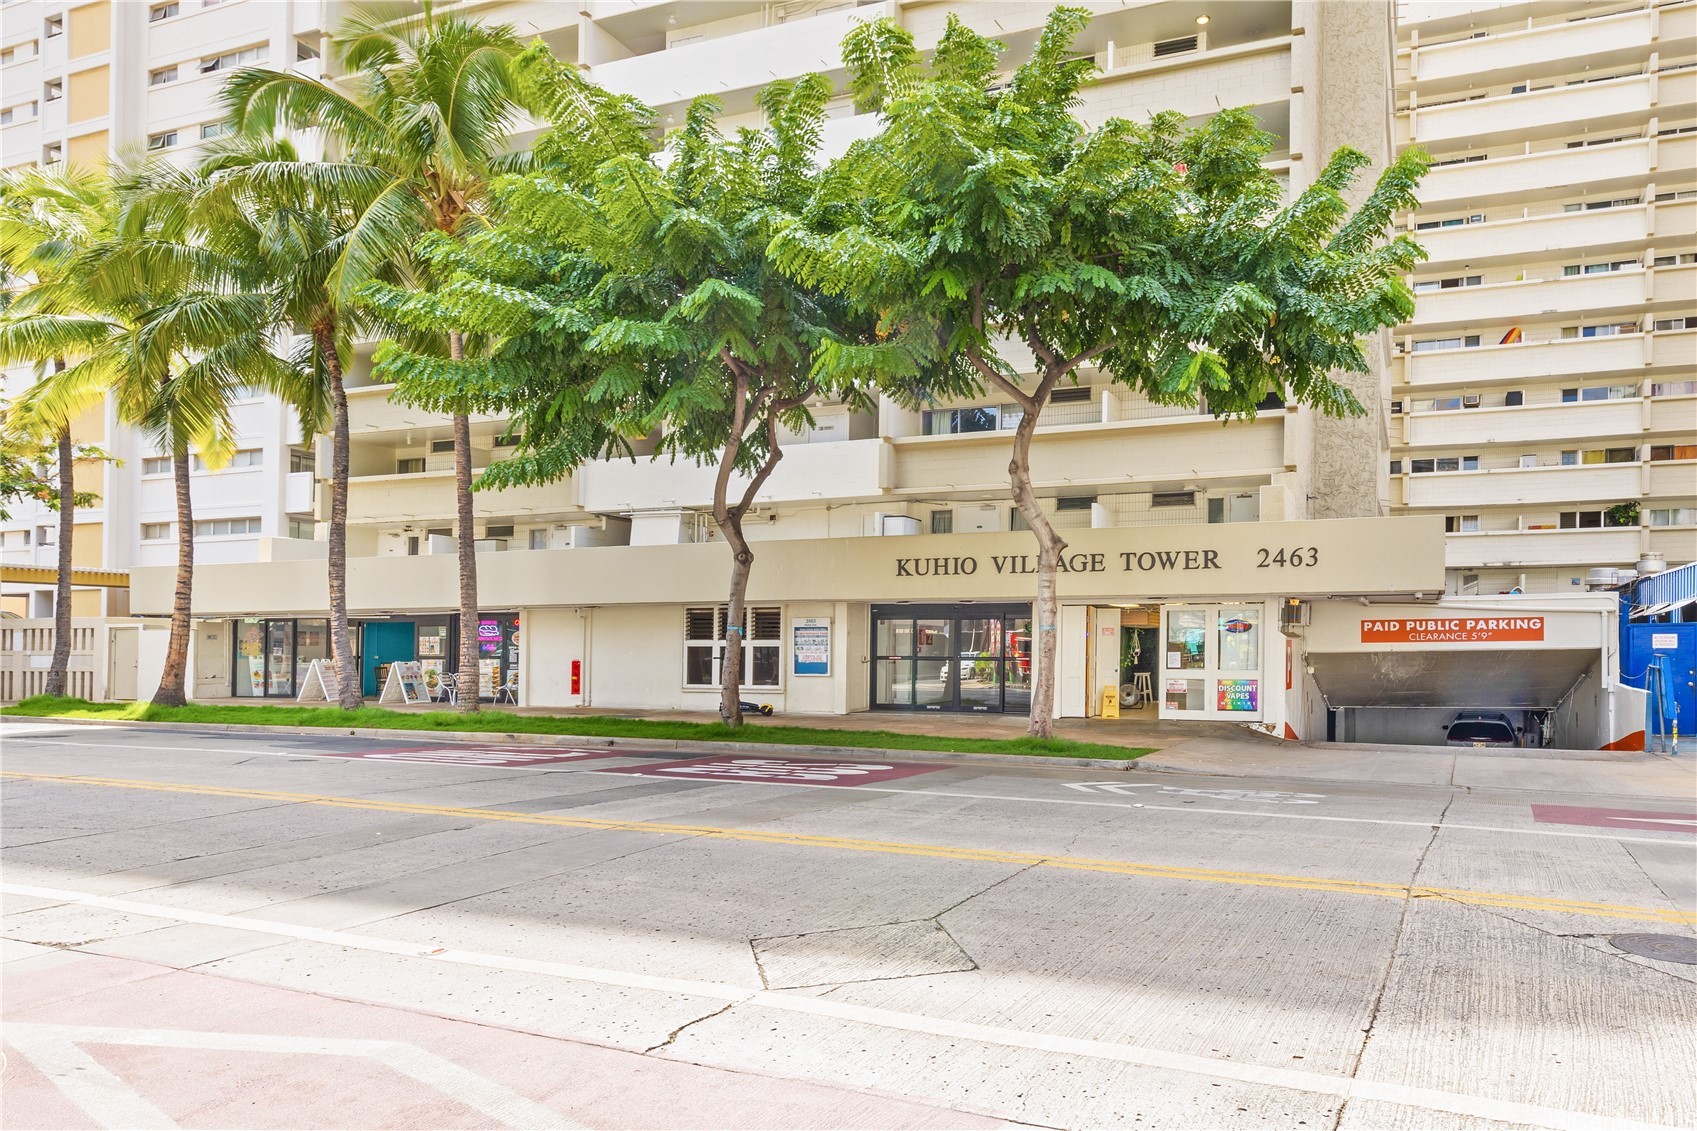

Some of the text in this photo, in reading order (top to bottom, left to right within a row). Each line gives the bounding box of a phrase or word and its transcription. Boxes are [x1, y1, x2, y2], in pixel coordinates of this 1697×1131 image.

[895, 547, 1319, 577] KUHIO VILAGE TOWER 2463
[1363, 618, 1542, 632] PAID PUBLIC PARKING
[1408, 632, 1468, 641] CLEARANCE
[1226, 692, 1250, 700] VAPES
